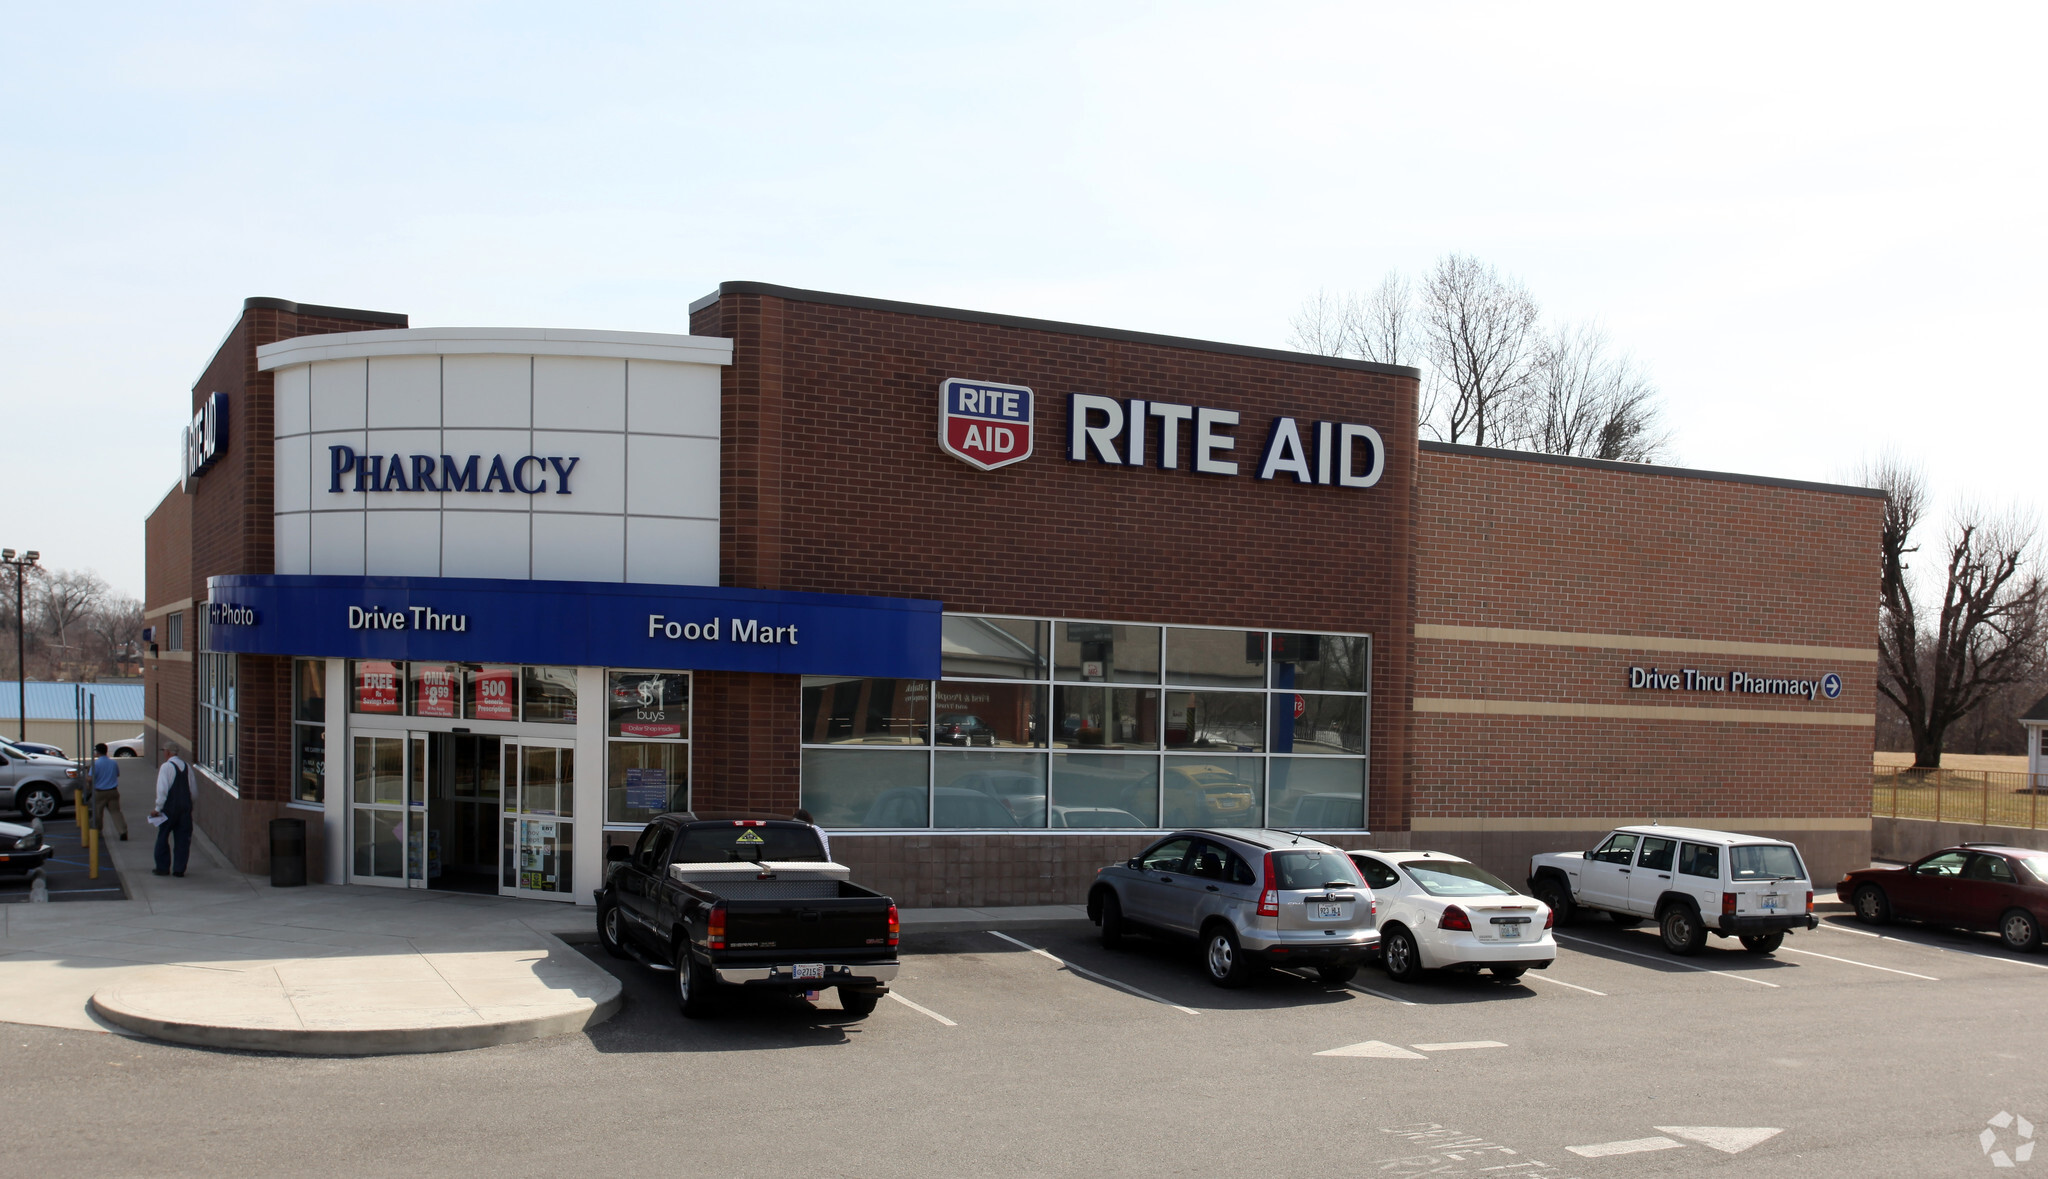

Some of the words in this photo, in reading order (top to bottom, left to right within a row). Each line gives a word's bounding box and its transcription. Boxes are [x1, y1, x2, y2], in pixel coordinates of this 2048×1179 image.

[958, 387, 1020, 417] RITE
[189, 406, 204, 477] RITE
[203, 392, 217, 463] AID
[962, 424, 1015, 454] AID
[1068, 392, 1240, 476] RITE
[1257, 417, 1385, 488] AID
[328, 445, 581, 494] PHARMACY
[222, 603, 254, 626] Photo
[349, 605, 405, 630] Drive
[409, 606, 466, 632] Thru
[649, 614, 720, 641] Food
[731, 618, 798, 645] Mart
[364, 673, 393, 689] FREE
[423, 671, 451, 686] ONLY
[481, 680, 506, 697] 500
[1631, 667, 1680, 690] Drive
[1683, 669, 1725, 692] Thru
[1731, 671, 1819, 701] Pharmacy
[363, 697, 382, 706] Savings
[484, 697, 504, 705] Generic
[637, 679, 666, 711] $1
[477, 704, 511, 714] Prescriptions
[637, 708, 665, 722] buys
